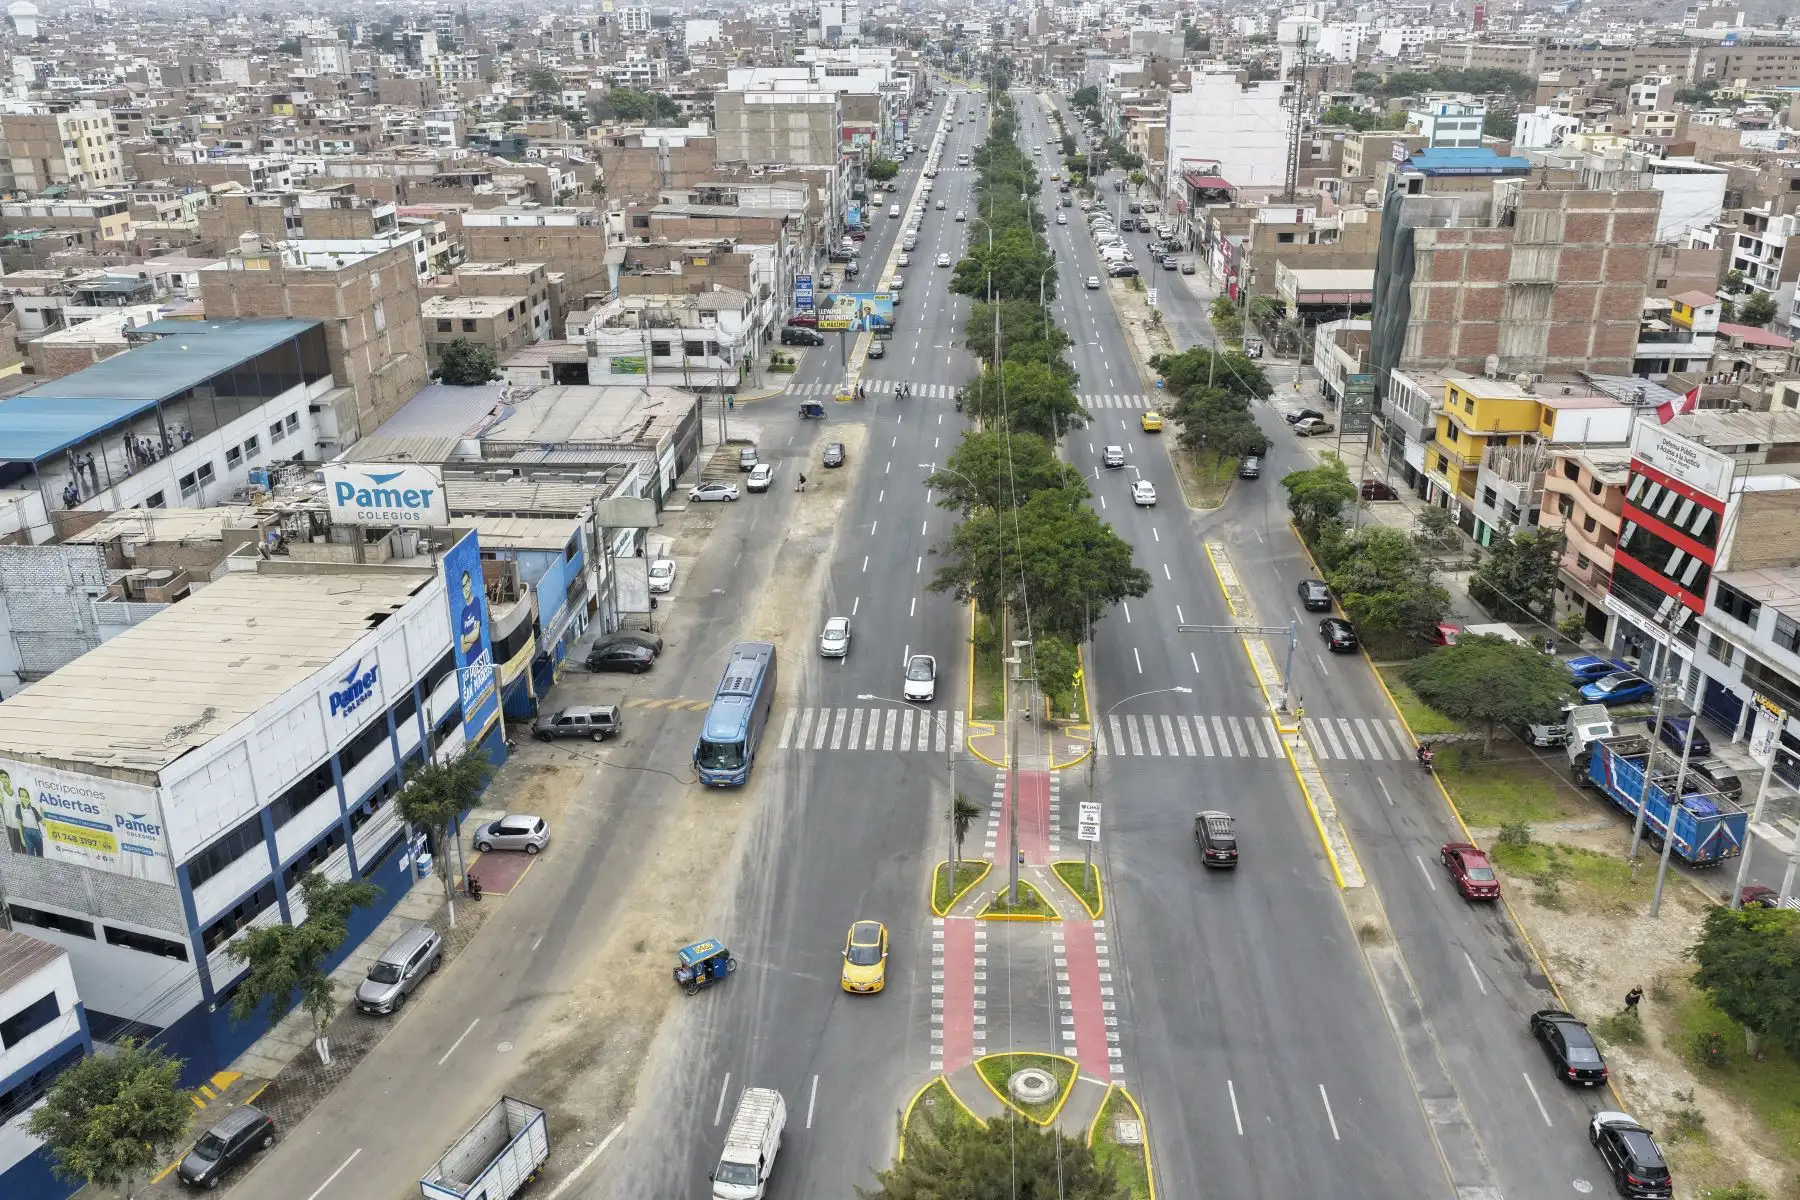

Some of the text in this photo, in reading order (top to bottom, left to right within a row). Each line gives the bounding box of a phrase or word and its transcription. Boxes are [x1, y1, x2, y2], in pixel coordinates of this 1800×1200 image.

[335, 481, 434, 508] Pamer
[358, 512, 420, 520] COLEGIOS
[329, 665, 378, 717] Pamer
[34, 777, 106, 800] Inscripciones
[39, 792, 100, 815] Abiertas
[52, 831, 61, 840] 01
[115, 814, 161, 836] Pamer
